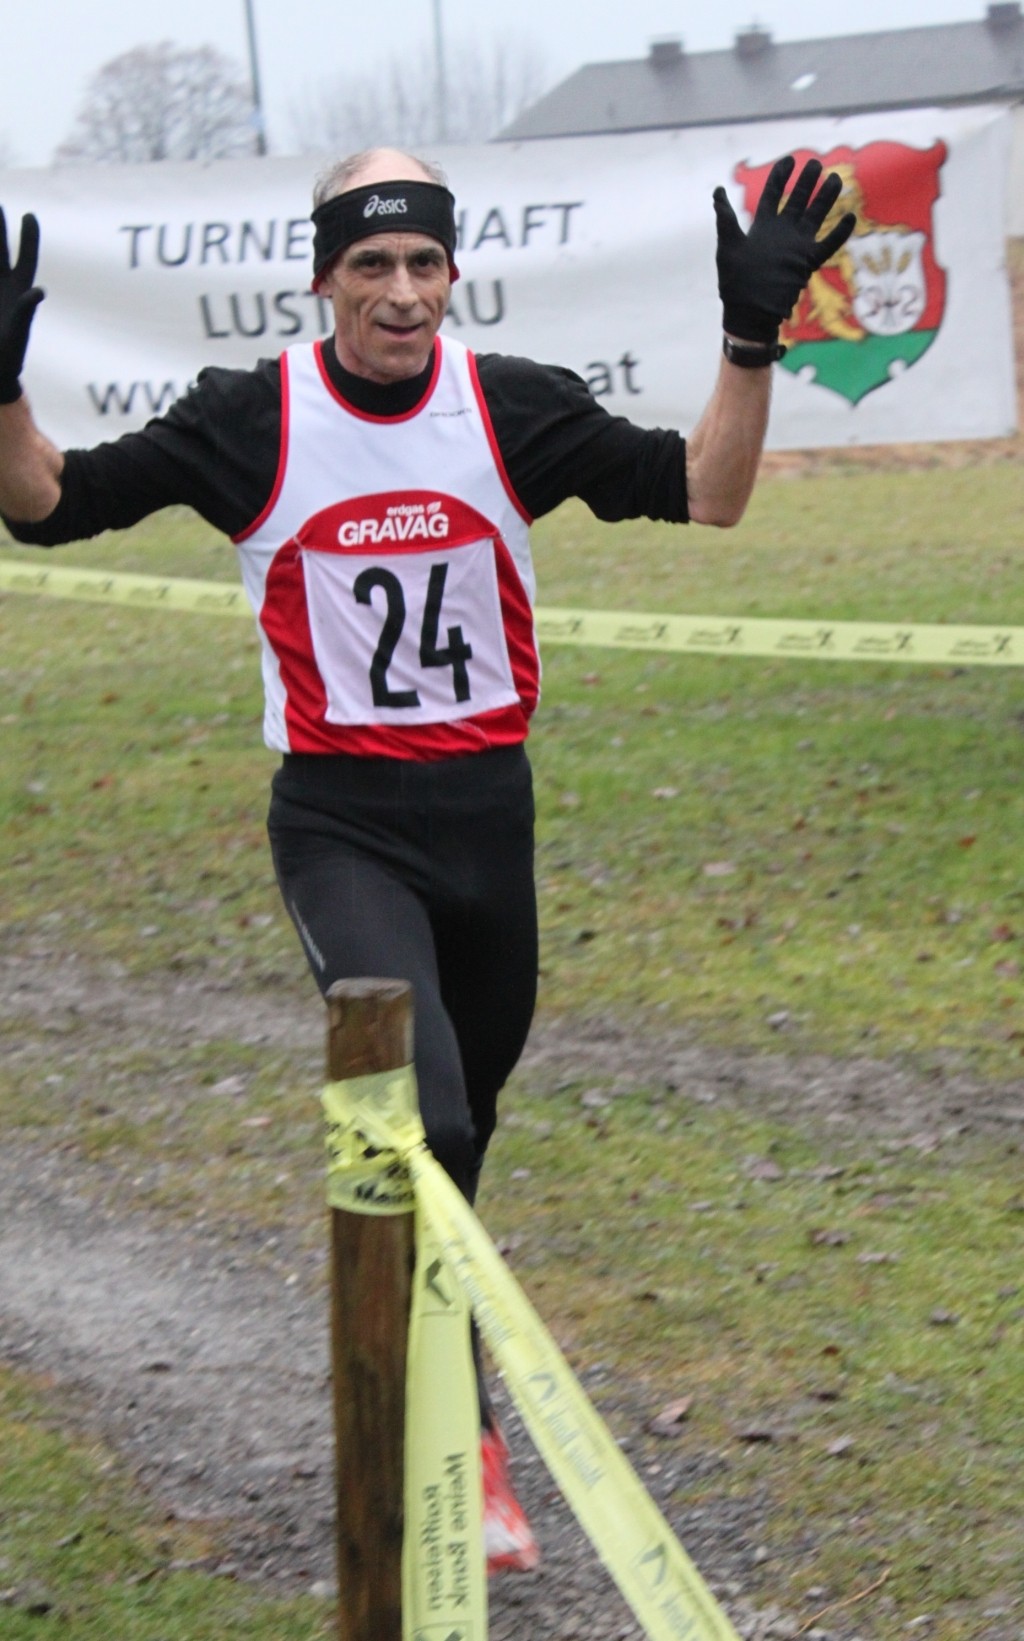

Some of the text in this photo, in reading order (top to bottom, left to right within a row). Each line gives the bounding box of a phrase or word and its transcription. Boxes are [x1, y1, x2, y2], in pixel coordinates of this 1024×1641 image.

[376, 198, 408, 216] asics
[386, 504, 425, 517] erdgas
[338, 513, 449, 547] GRAVAG
[352, 561, 473, 708] 24
